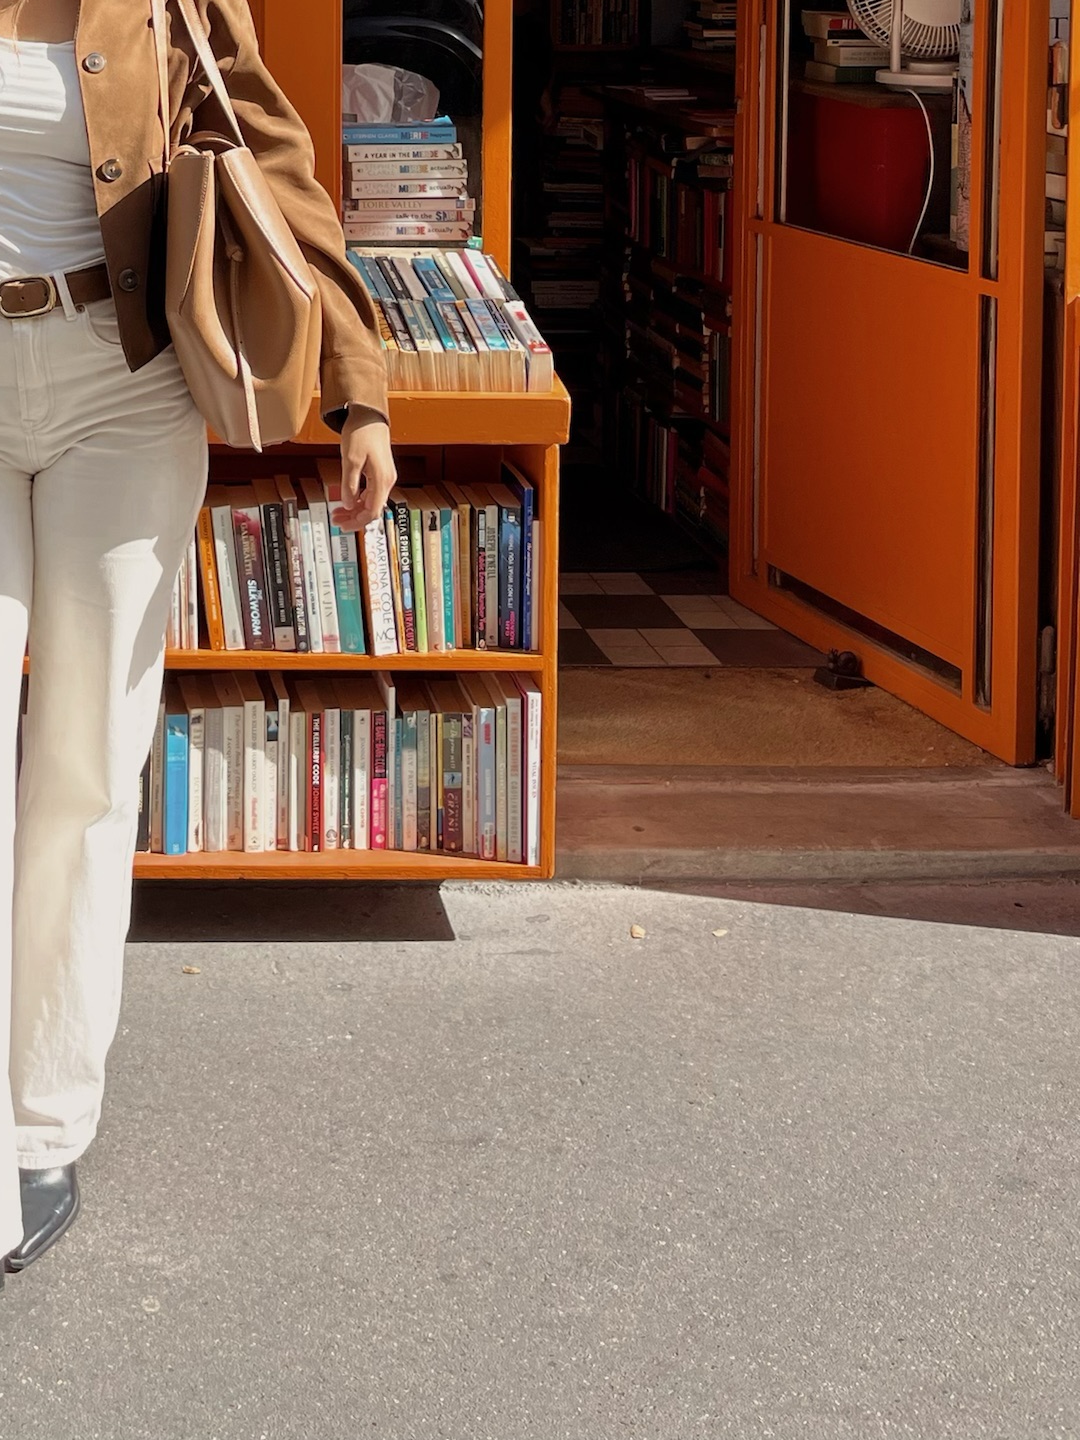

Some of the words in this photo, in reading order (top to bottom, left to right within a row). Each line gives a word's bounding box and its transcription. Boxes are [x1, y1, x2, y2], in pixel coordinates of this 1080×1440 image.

[362, 201, 388, 209] LOIRE
[397, 507, 406, 534] DELIA
[240, 522, 254, 576] GALBRAITH
[249, 535, 257, 562] ROBERT
[314, 522, 326, 564] crazed
[340, 536, 350, 562] HUTTON
[487, 526, 496, 552] JOSEPH
[290, 545, 301, 577] CHILDREN
[375, 535, 389, 588] MARTINA
[399, 535, 410, 572] EPHRON
[487, 553, 497, 580] O'NEILL
[293, 577, 302, 586] OF
[367, 551, 378, 591] GOOD
[477, 571, 486, 592] Enemy
[507, 564, 515, 584] WHAT
[294, 586, 303, 599] THE
[321, 580, 331, 596] HA
[246, 579, 262, 636] SILKWORM
[322, 600, 333, 618] JIN
[370, 592, 381, 613] LIFE
[380, 592, 392, 624] COLE
[478, 592, 486, 618] Number
[296, 599, 307, 636] REVOLUTION
[404, 609, 415, 649] SIRACUSA
[478, 618, 486, 631] Two
[312, 718, 320, 731] THE
[375, 714, 385, 726] THE
[510, 712, 518, 725] THE
[312, 731, 320, 764] KELLERBY
[375, 726, 385, 758] BANG-BANG
[510, 727, 519, 777] ALTERNATIVES
[312, 763, 320, 785] CODE
[375, 758, 385, 774] CLUB
[312, 786, 320, 811] JONNY
[312, 811, 320, 835] SWEET
[447, 792, 456, 833] CRANE
[510, 815, 519, 844] HUGHES
